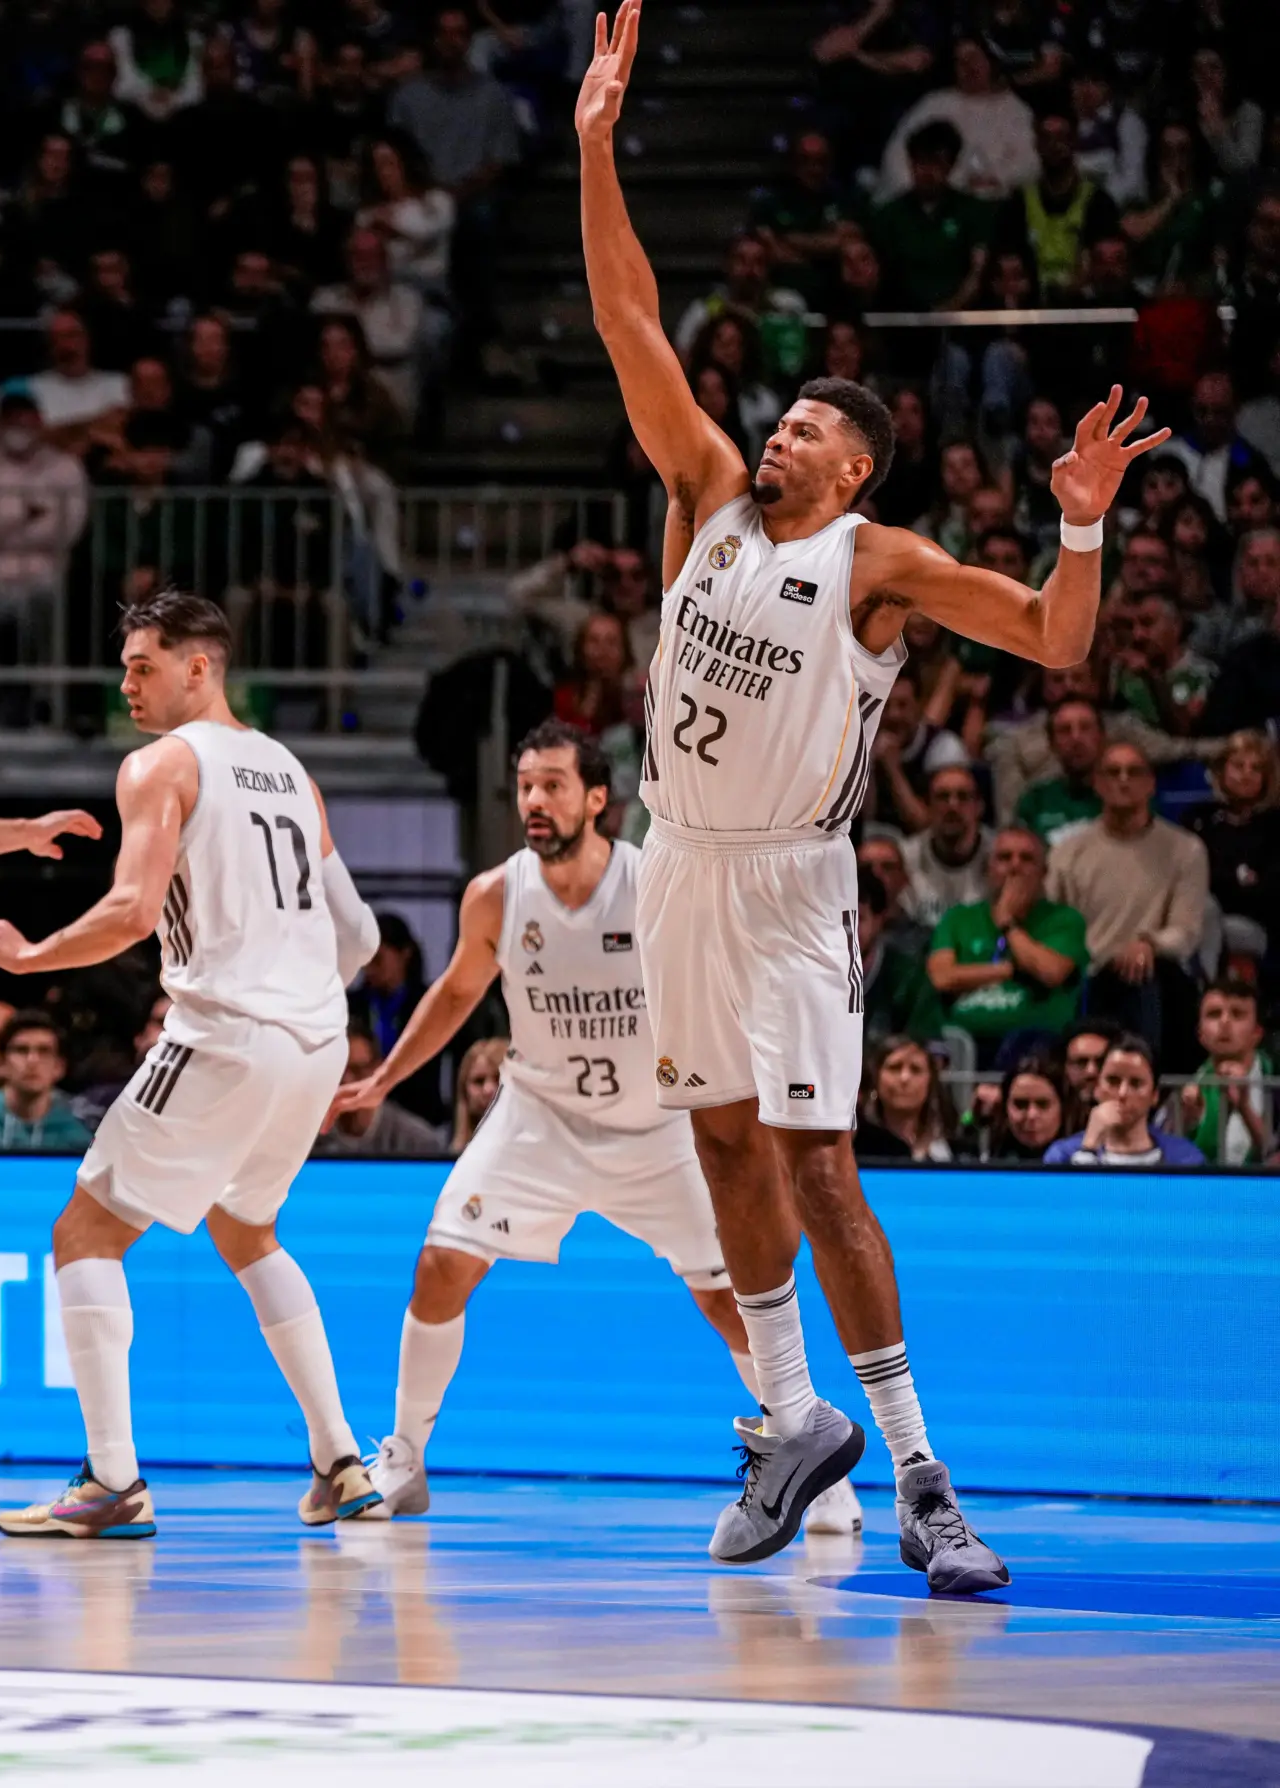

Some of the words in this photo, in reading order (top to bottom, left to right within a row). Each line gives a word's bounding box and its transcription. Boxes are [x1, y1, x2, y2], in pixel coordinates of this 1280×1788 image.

[783, 590, 813, 603] endesa
[676, 595, 804, 675] Emirates
[678, 641, 707, 675] FLY
[703, 657, 773, 701] BETTER
[673, 692, 728, 767] 22
[232, 765, 298, 796] HEZONJA
[550, 1018, 572, 1039] FLY
[579, 1016, 638, 1040] BETTER
[568, 1055, 620, 1097] 23
[790, 1087, 810, 1098] acb
